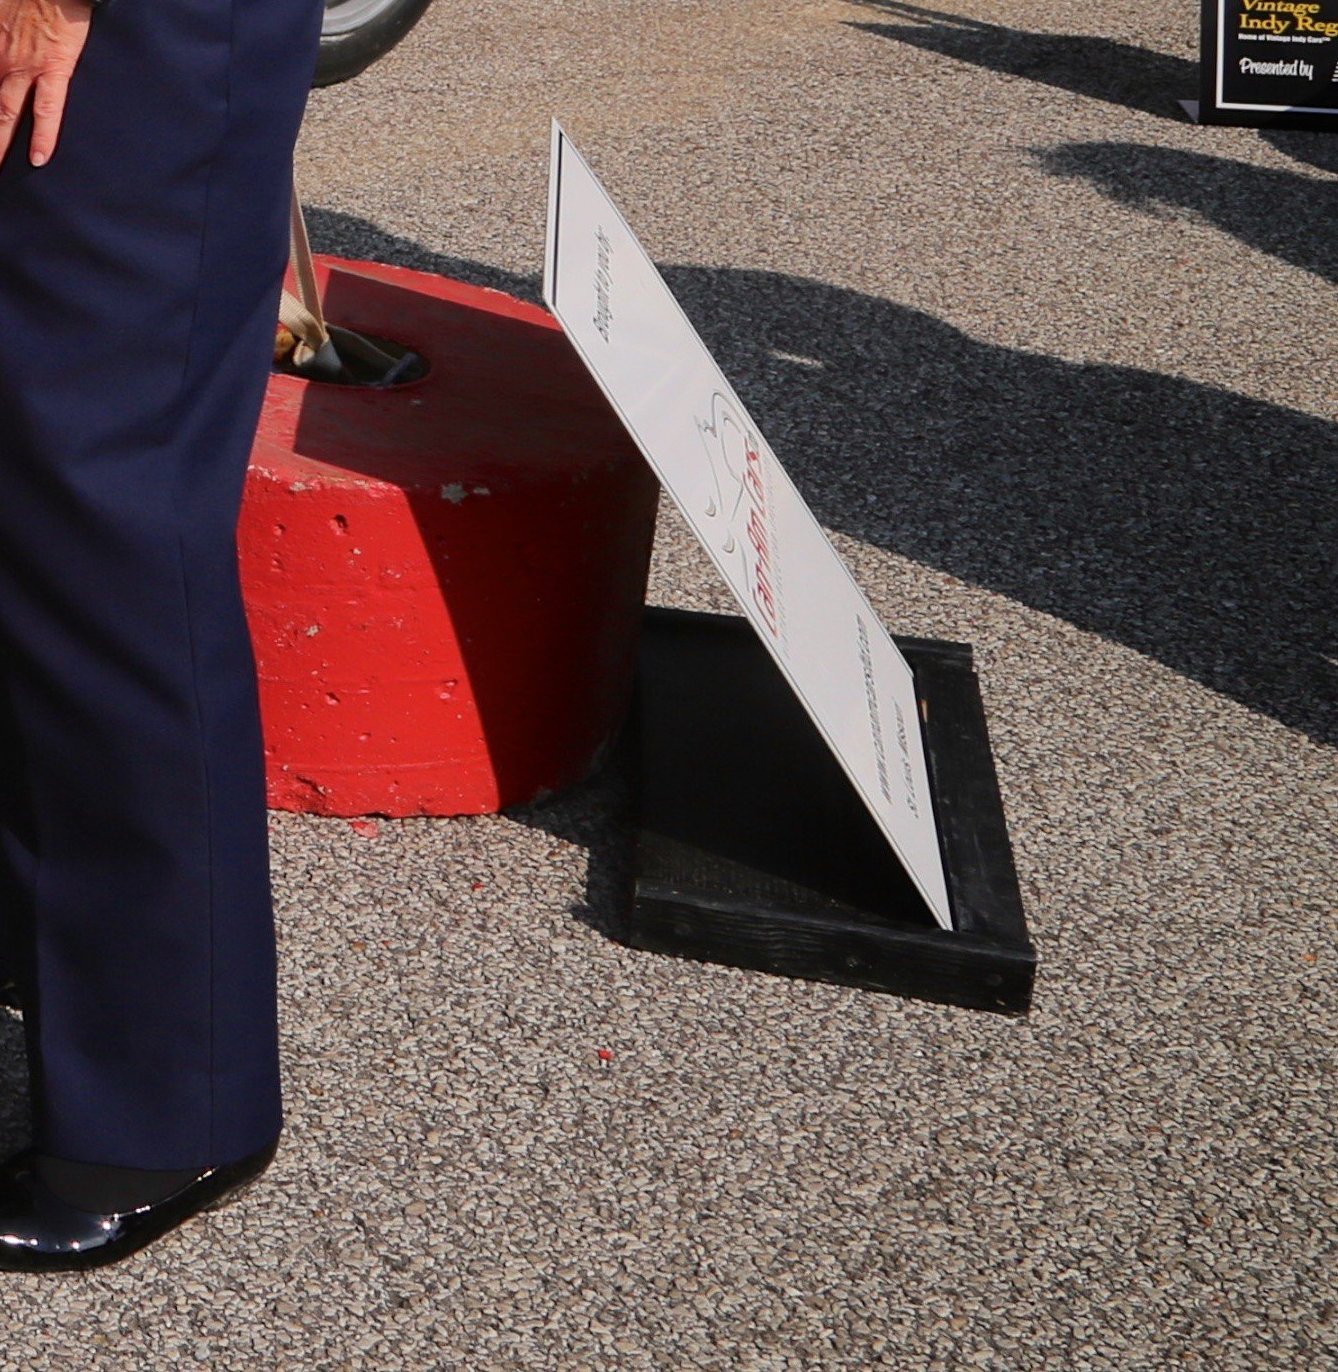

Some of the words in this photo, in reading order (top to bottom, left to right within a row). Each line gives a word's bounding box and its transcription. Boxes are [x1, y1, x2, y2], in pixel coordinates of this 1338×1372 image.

[1239, 13, 1291, 35] Indy
[1295, 16, 1338, 37] Reg
[1238, 33, 1258, 41] Home
[1266, 34, 1291, 43] Vintage
[1239, 56, 1298, 76] Presented
[1299, 59, 1314, 81] by
[592, 275, 613, 344] Brought
[747, 507, 778, 638] Can-Am
